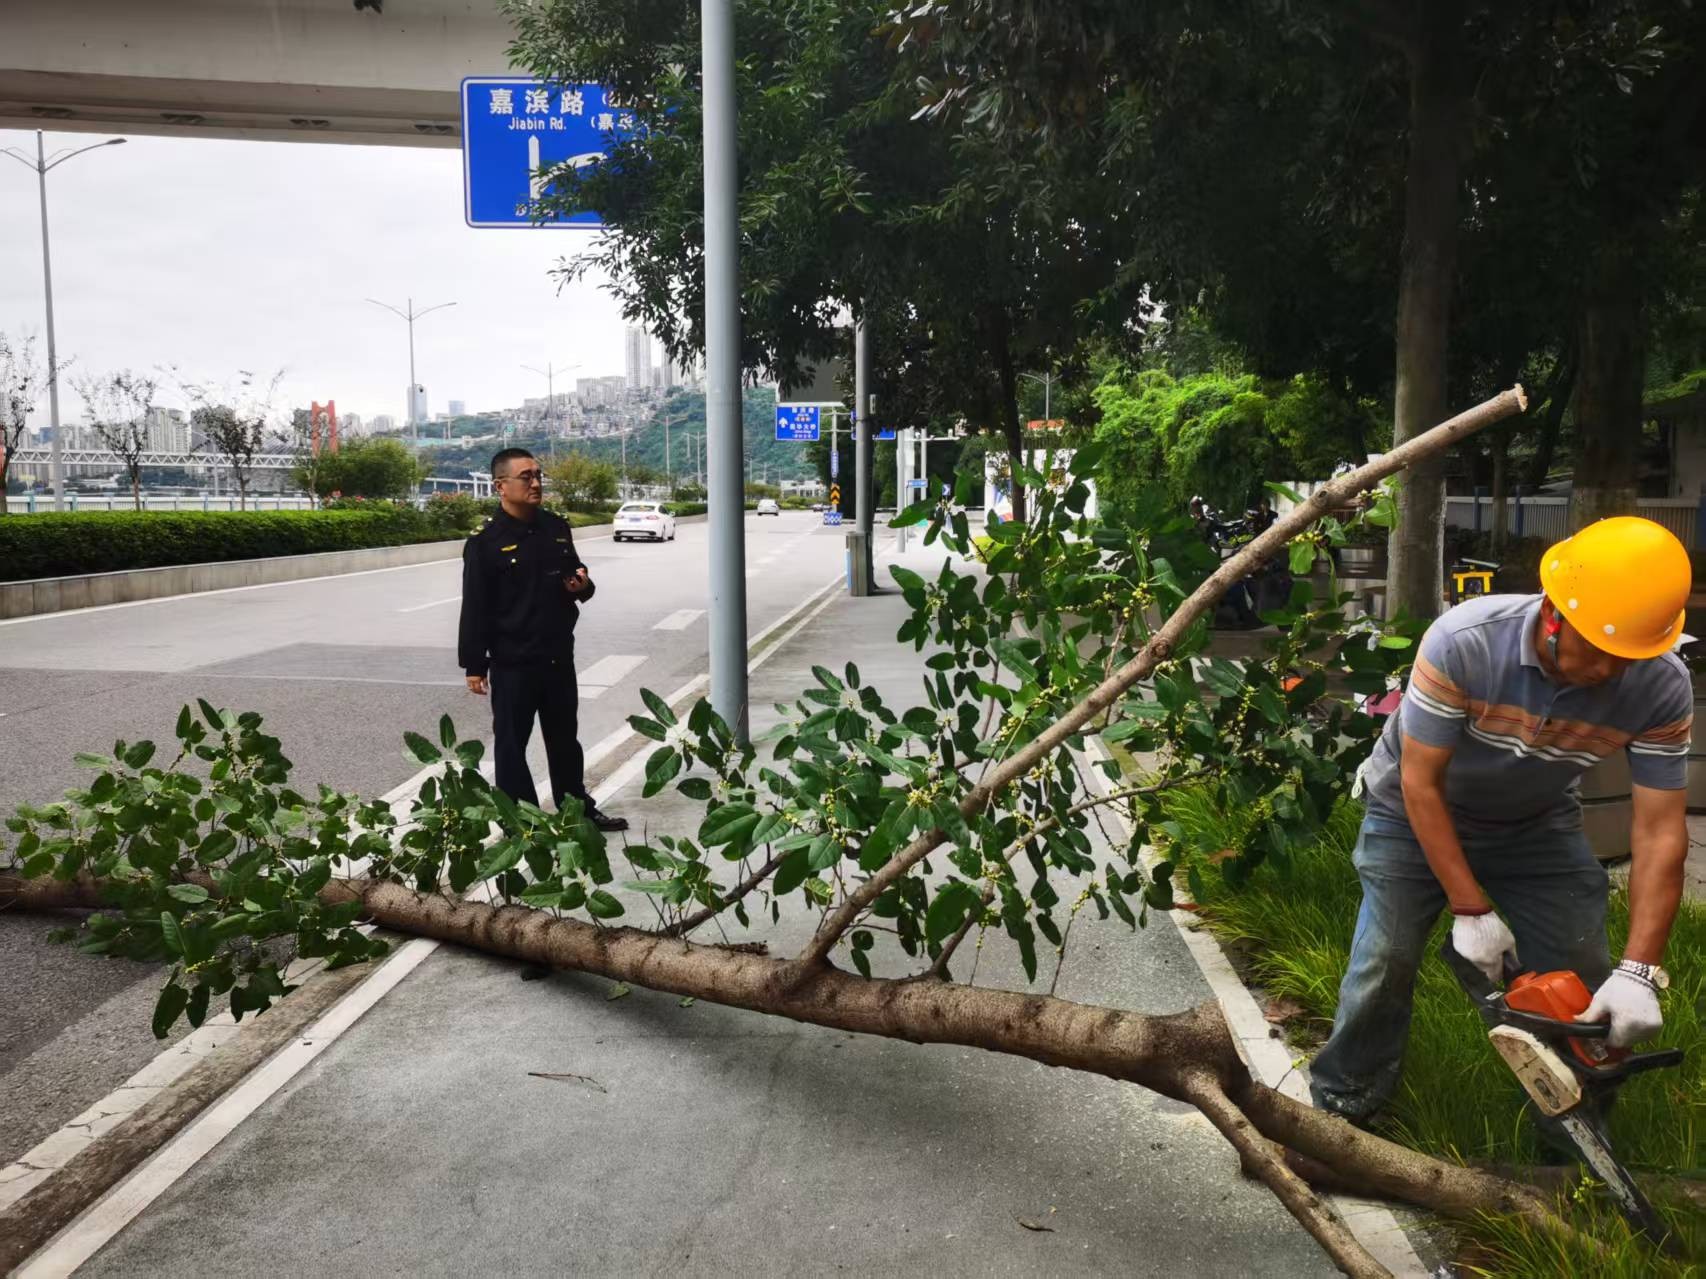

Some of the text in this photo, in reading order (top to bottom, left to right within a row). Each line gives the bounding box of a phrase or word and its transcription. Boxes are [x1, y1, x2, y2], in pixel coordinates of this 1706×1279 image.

[489, 88, 584, 116] 嘉滨路
[508, 117, 567, 130] Jiabin Rd.
